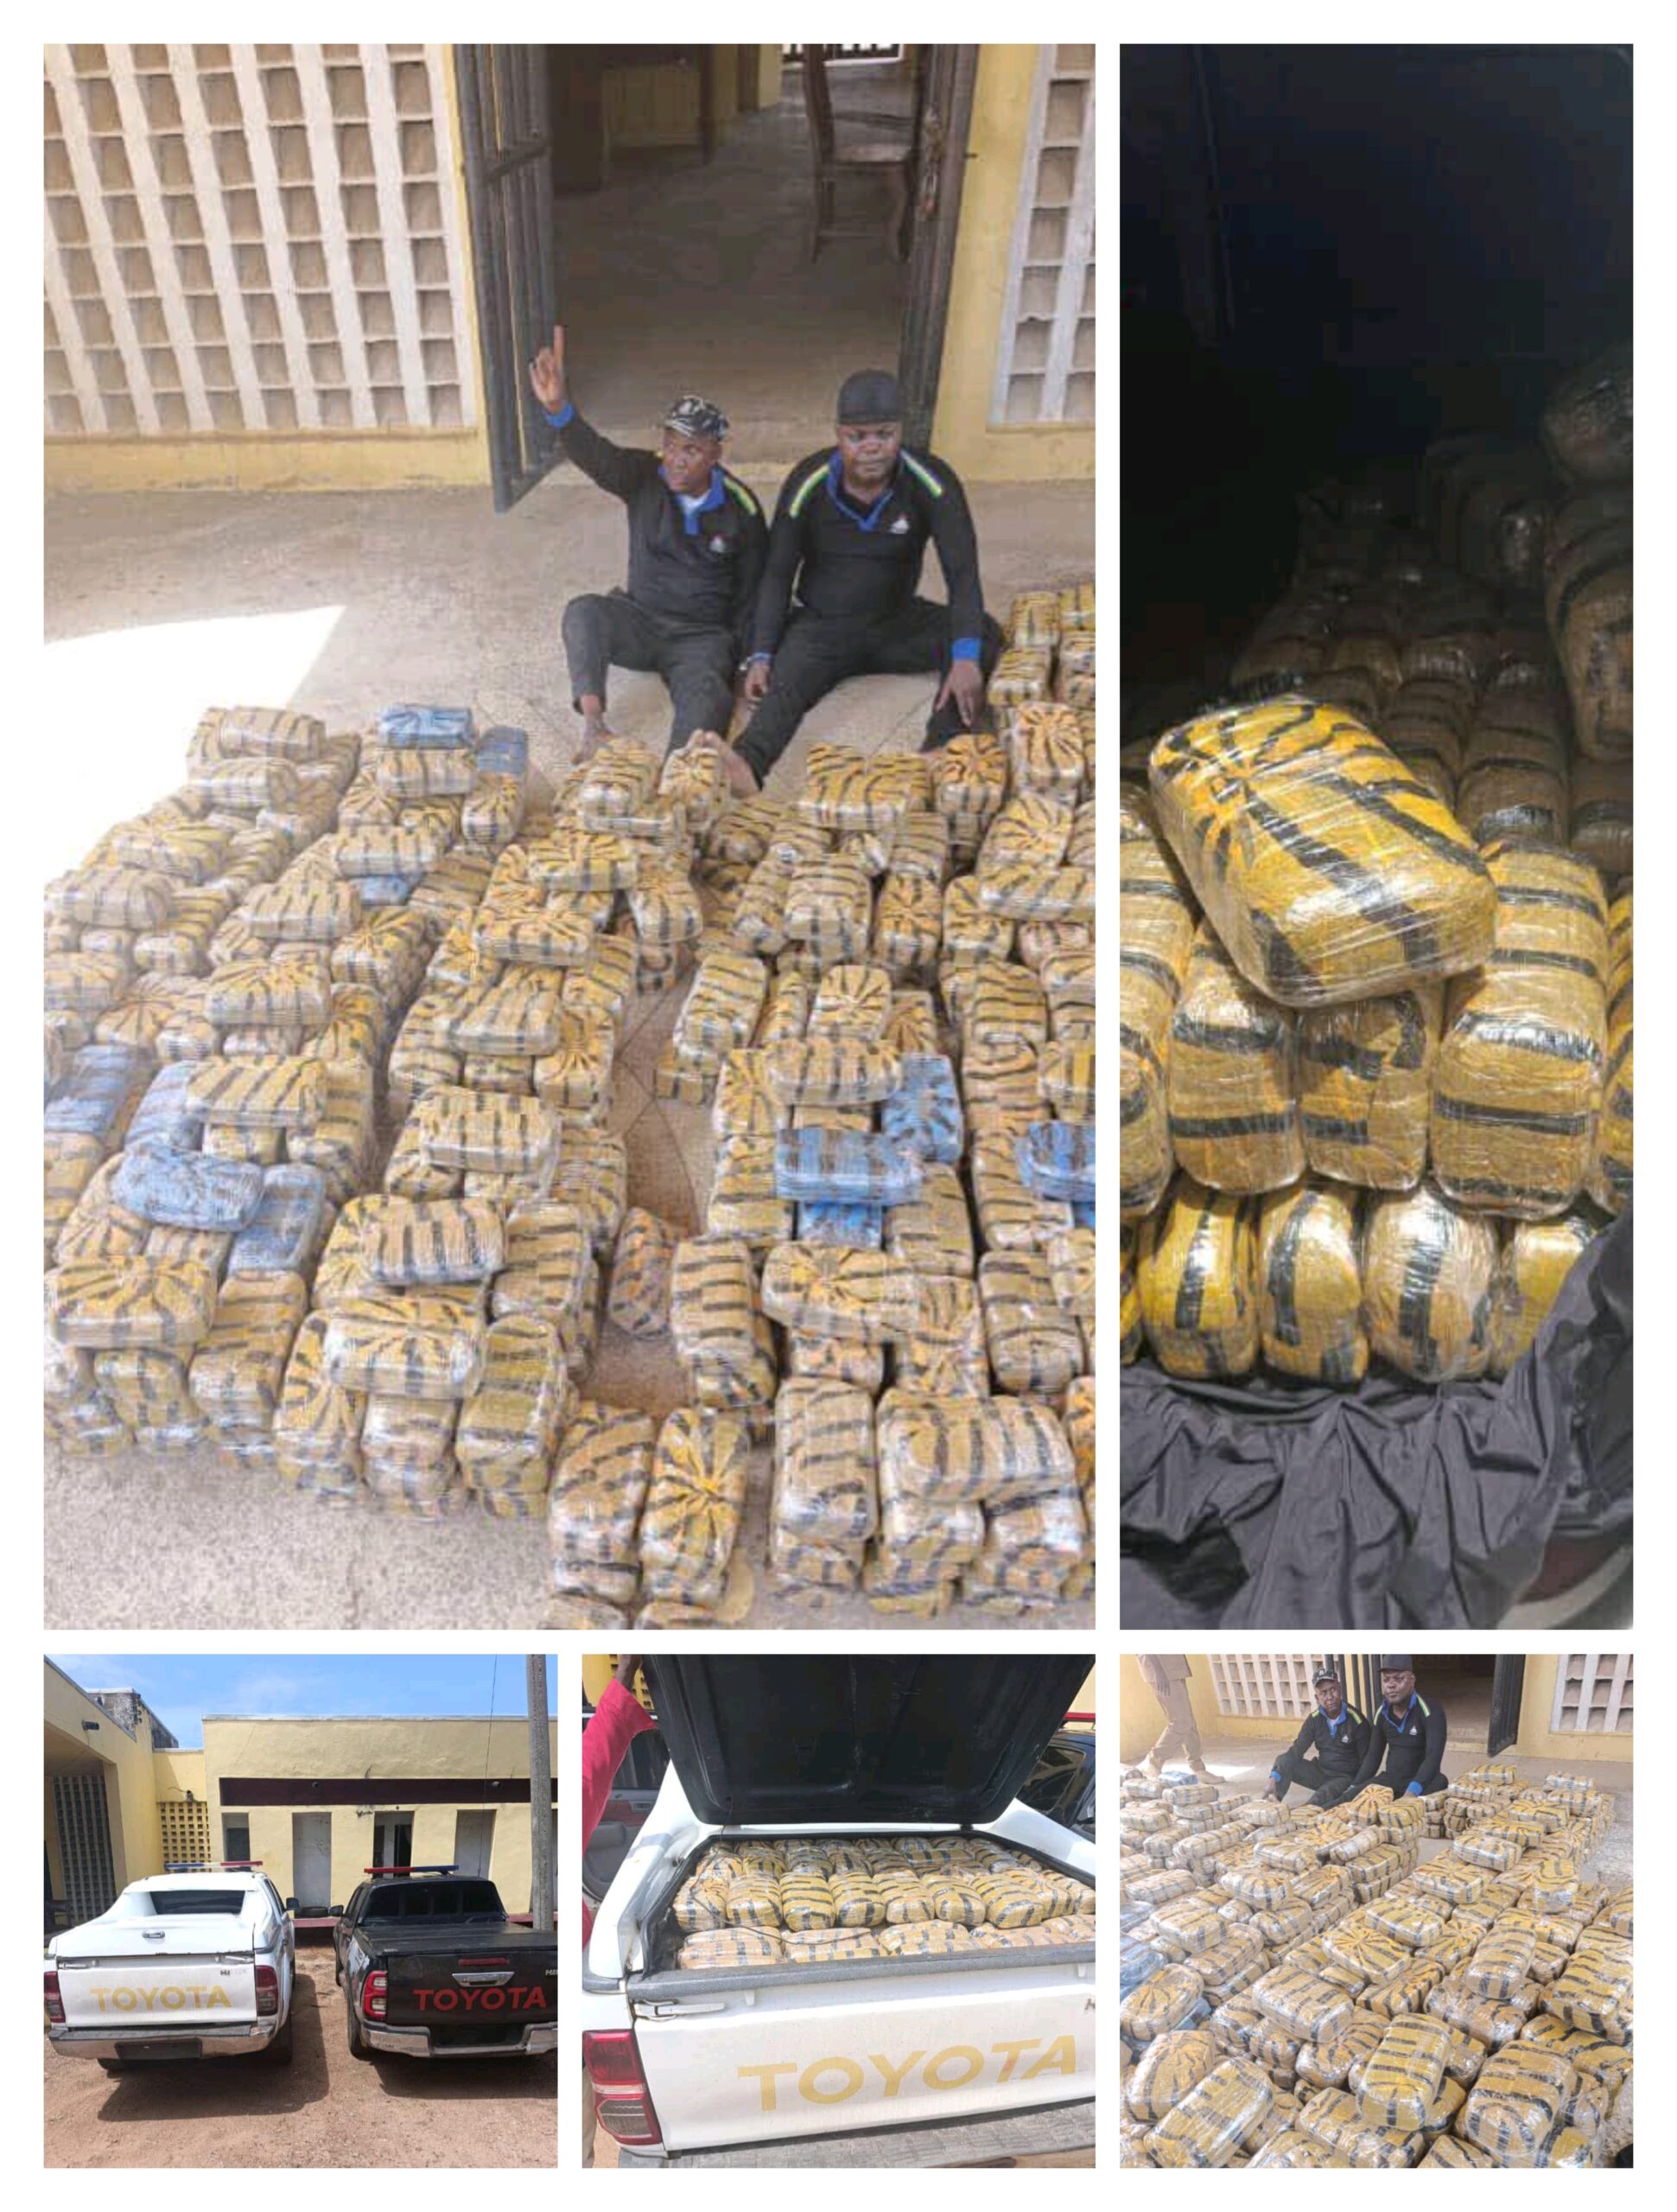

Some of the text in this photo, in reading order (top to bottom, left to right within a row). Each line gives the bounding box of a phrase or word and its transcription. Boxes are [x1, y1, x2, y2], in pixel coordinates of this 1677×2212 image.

[89, 1986, 232, 2012] TOYOTA
[413, 1986, 548, 2012] TOYOTA
[737, 2035, 1077, 2111] TOYOTA
